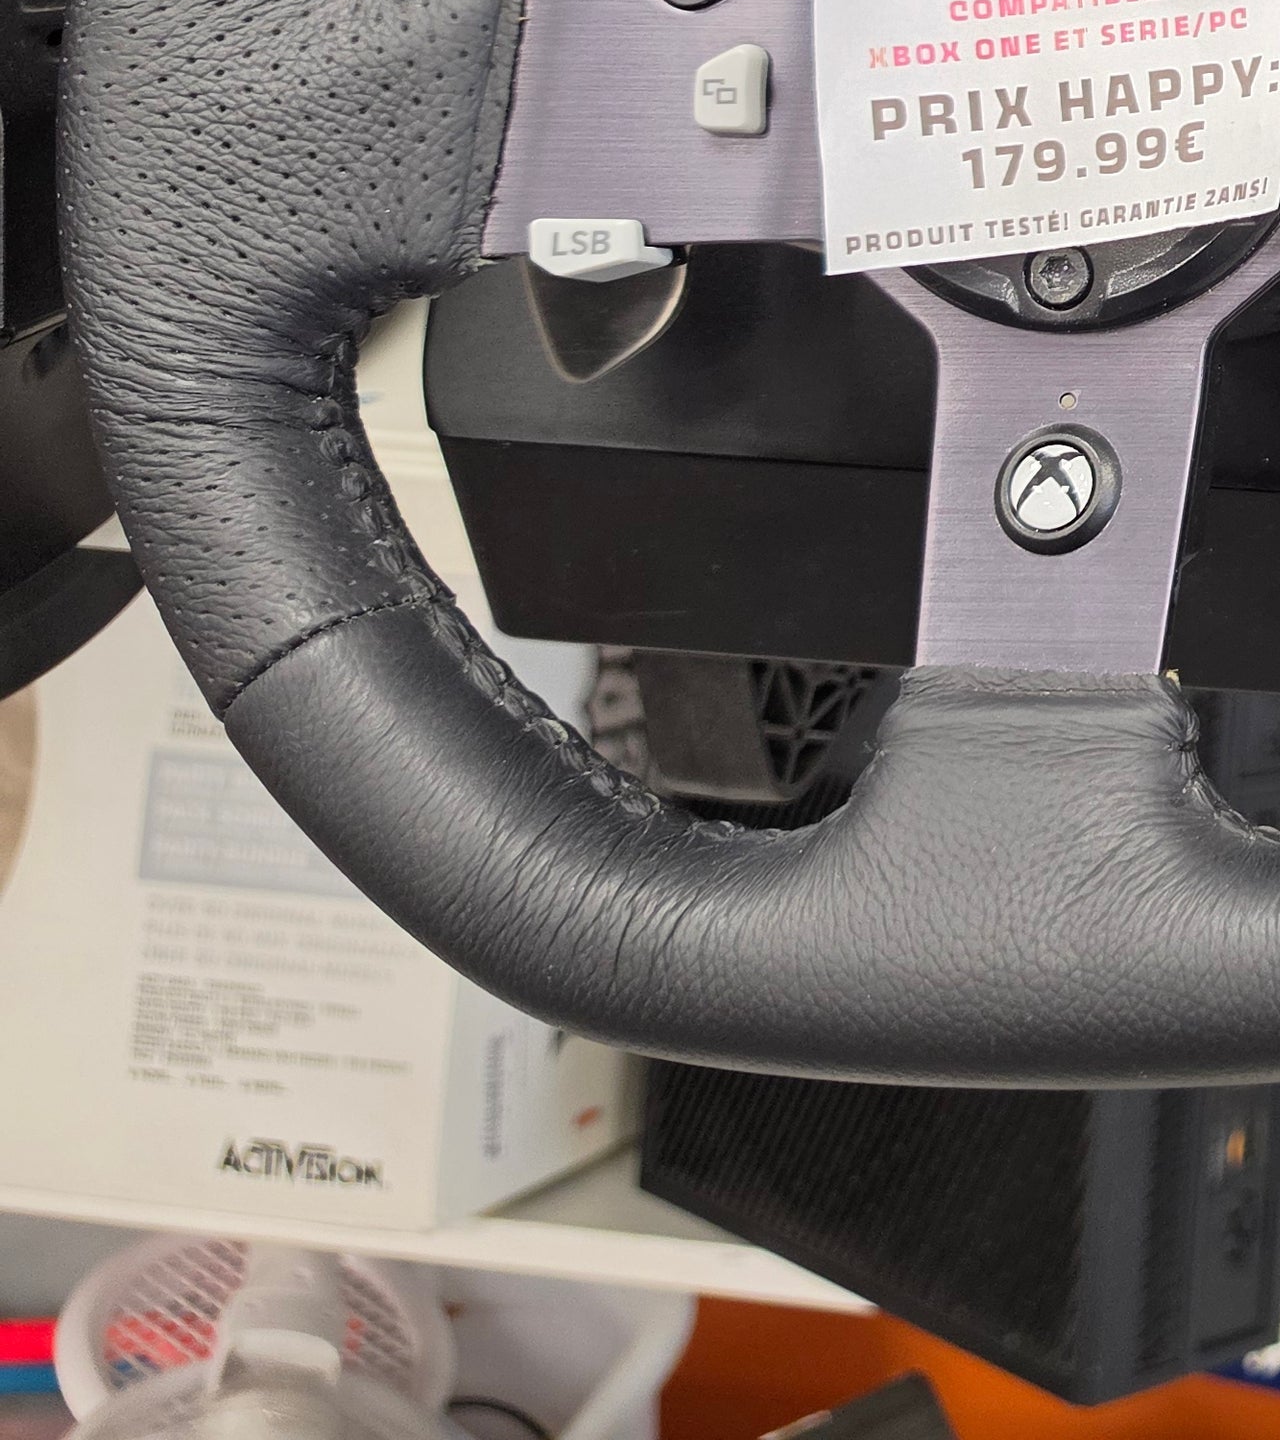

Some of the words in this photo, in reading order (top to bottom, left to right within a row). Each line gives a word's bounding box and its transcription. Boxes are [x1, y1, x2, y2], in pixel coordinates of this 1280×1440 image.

[869, 40, 961, 68] XBOX
[976, 33, 1041, 61] ONE
[1054, 27, 1088, 52] ET
[1101, 8, 1248, 46] SERIE/PC
[871, 85, 1032, 141] PRIX
[1059, 55, 1280, 121] HAPPY:
[962, 121, 1205, 189] 179.99€
[552, 230, 611, 256] LSB
[846, 223, 974, 255] PRODUIT
[986, 209, 1070, 240] TESTÉ!
[1081, 194, 1197, 229] GARANTIE
[221, 1137, 386, 1187] ACTIVISION
